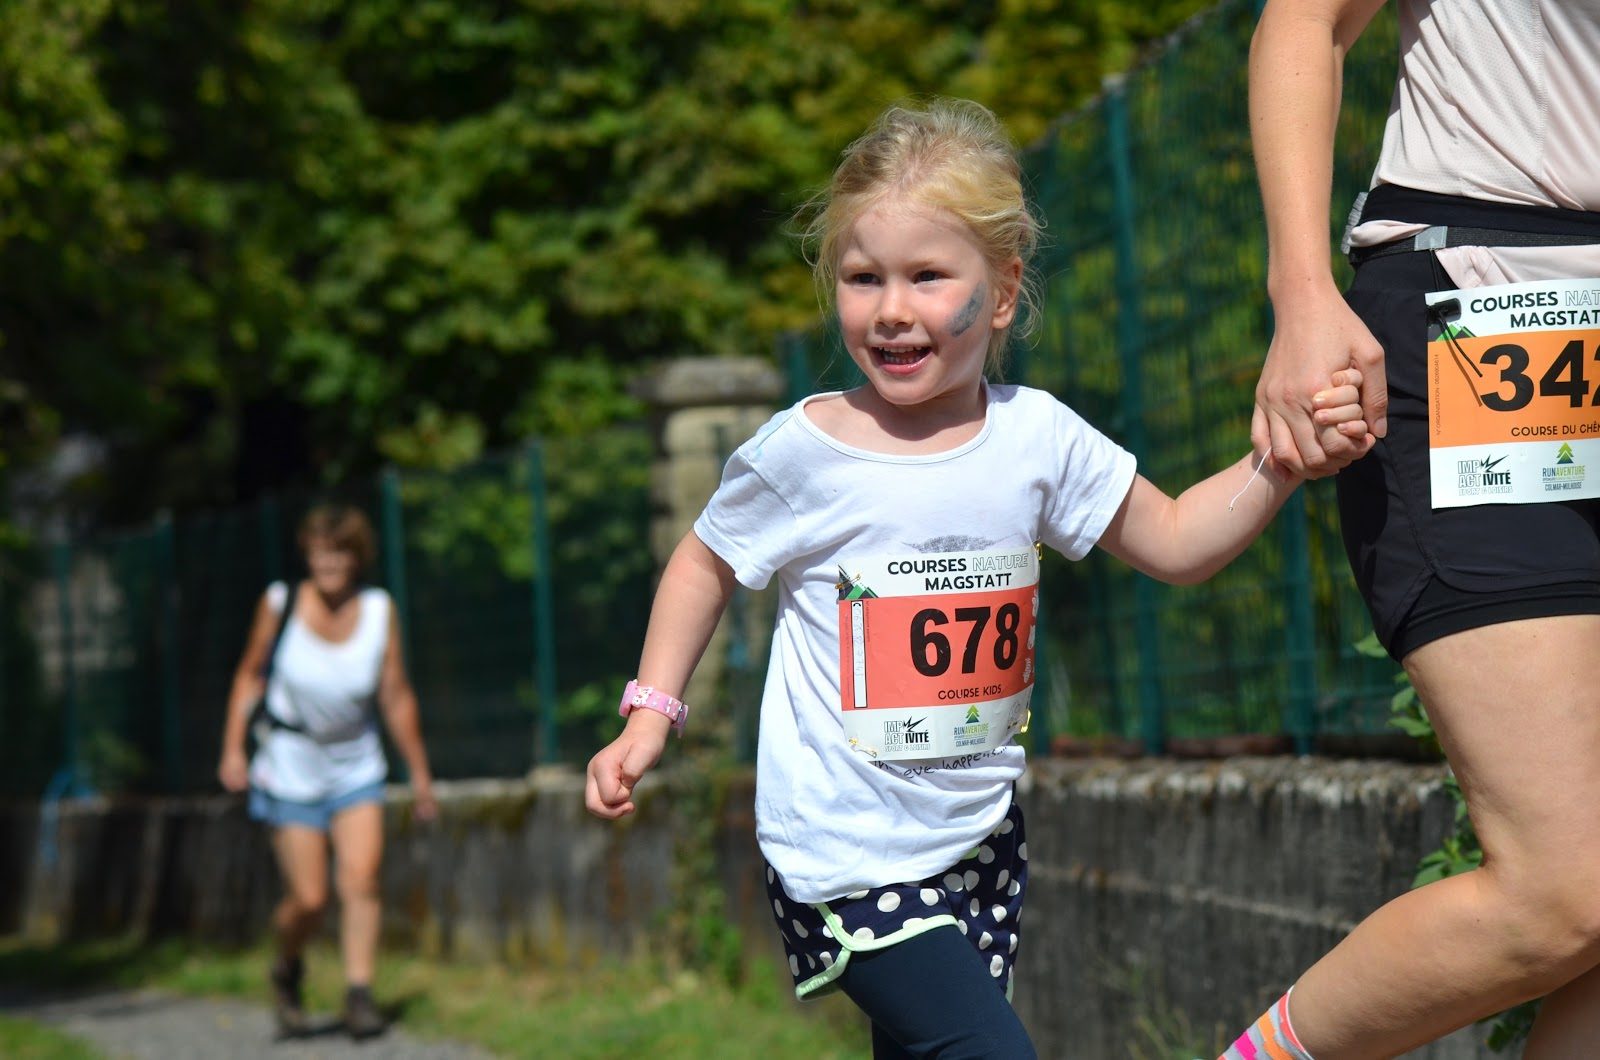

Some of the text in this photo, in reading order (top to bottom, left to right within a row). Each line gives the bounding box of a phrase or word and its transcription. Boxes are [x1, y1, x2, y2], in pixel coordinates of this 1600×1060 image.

[1470, 291, 1558, 313] COURSES
[1480, 339, 1600, 412] 34
[1511, 420, 1600, 437] COURSE DU CHÊ
[888, 553, 1028, 575] COURSES NATURE
[925, 573, 1011, 591] MAGSTATT
[910, 602, 1020, 677] 678
[938, 684, 1002, 700] COURSE KIDS
